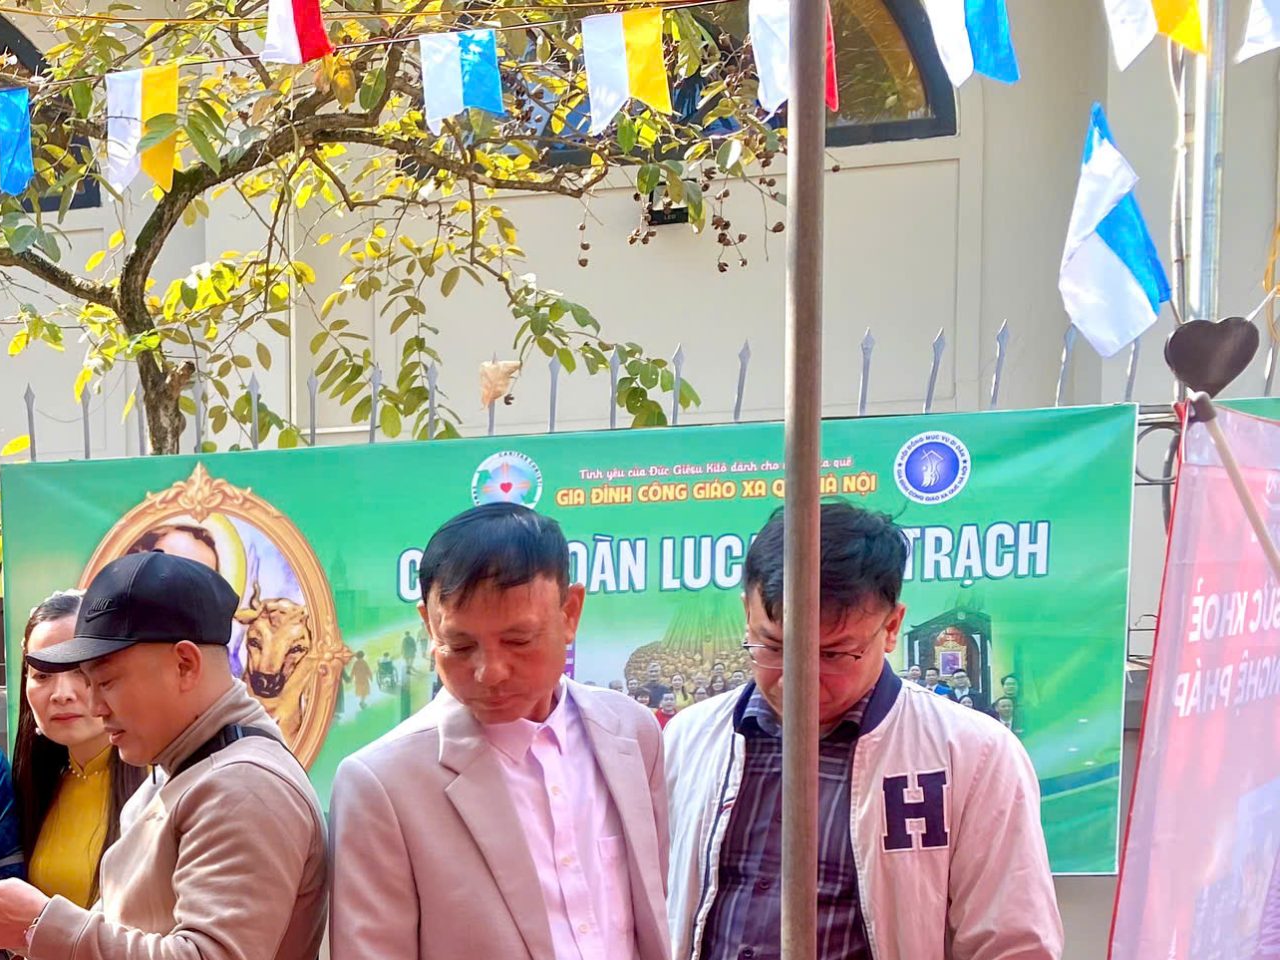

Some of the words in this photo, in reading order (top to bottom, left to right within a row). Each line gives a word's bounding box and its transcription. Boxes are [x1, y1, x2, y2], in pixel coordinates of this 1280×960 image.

[761, 460, 780, 471] cho
[556, 484, 586, 507] GIA
[590, 480, 633, 506] ĐÌNH
[637, 478, 688, 504] CÔNG
[693, 475, 736, 501] GIÁO
[741, 477, 767, 498] XA
[842, 471, 877, 496] NỘI
[902, 520, 1051, 588] TRẠCH
[882, 767, 951, 852] H
